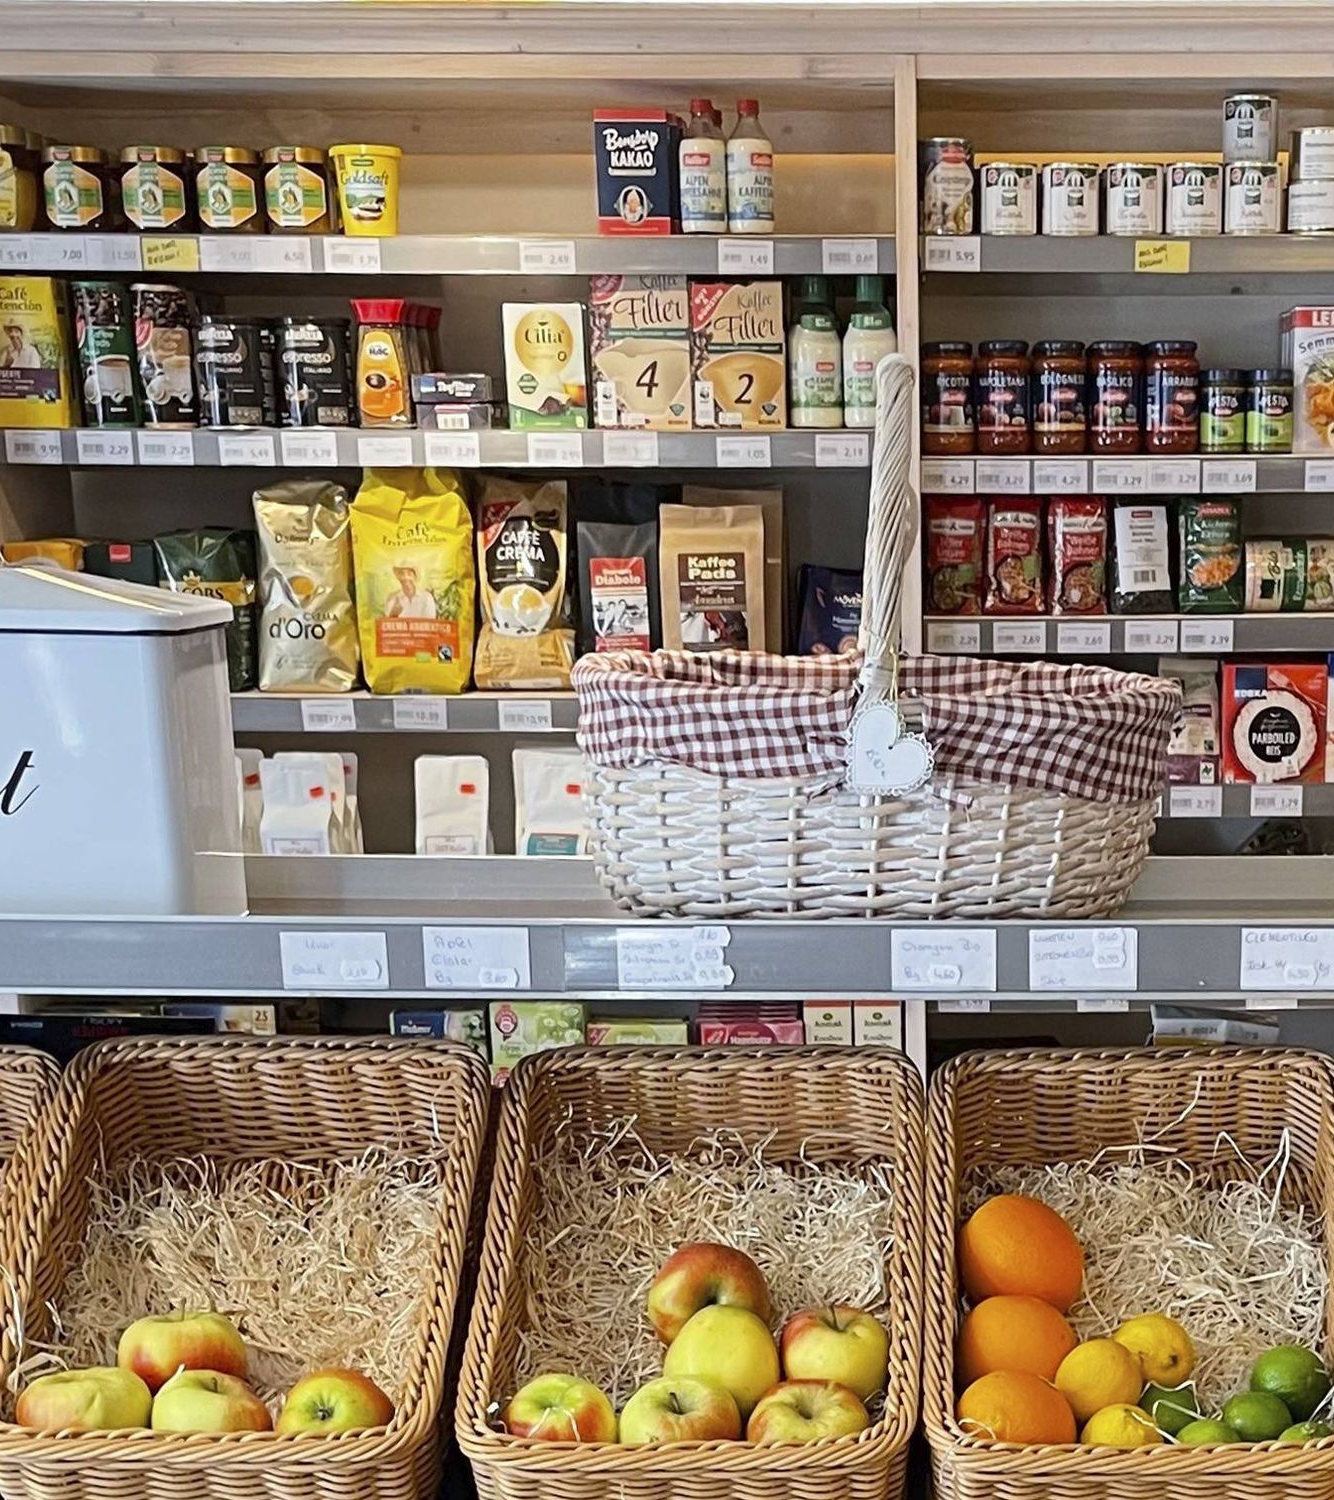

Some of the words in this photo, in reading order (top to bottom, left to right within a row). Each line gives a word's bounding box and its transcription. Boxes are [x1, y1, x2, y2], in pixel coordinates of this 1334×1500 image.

[610, 150, 653, 167] KAKAO
[339, 170, 389, 187] Goldsaft
[613, 297, 683, 328] Filter
[524, 327, 563, 345] Cilia
[714, 314, 776, 345] Filter
[636, 361, 659, 398] 4
[734, 373, 754, 404] 2
[496, 546, 546, 562] CREMA
[687, 555, 737, 569] Kaffee
[687, 568, 737, 581] Pads
[269, 618, 326, 640] d'Oro
[1234, 688, 1267, 699] EDEKA
[1251, 731, 1296, 746] PARBOILED
[433, 934, 473, 950] Apfel
